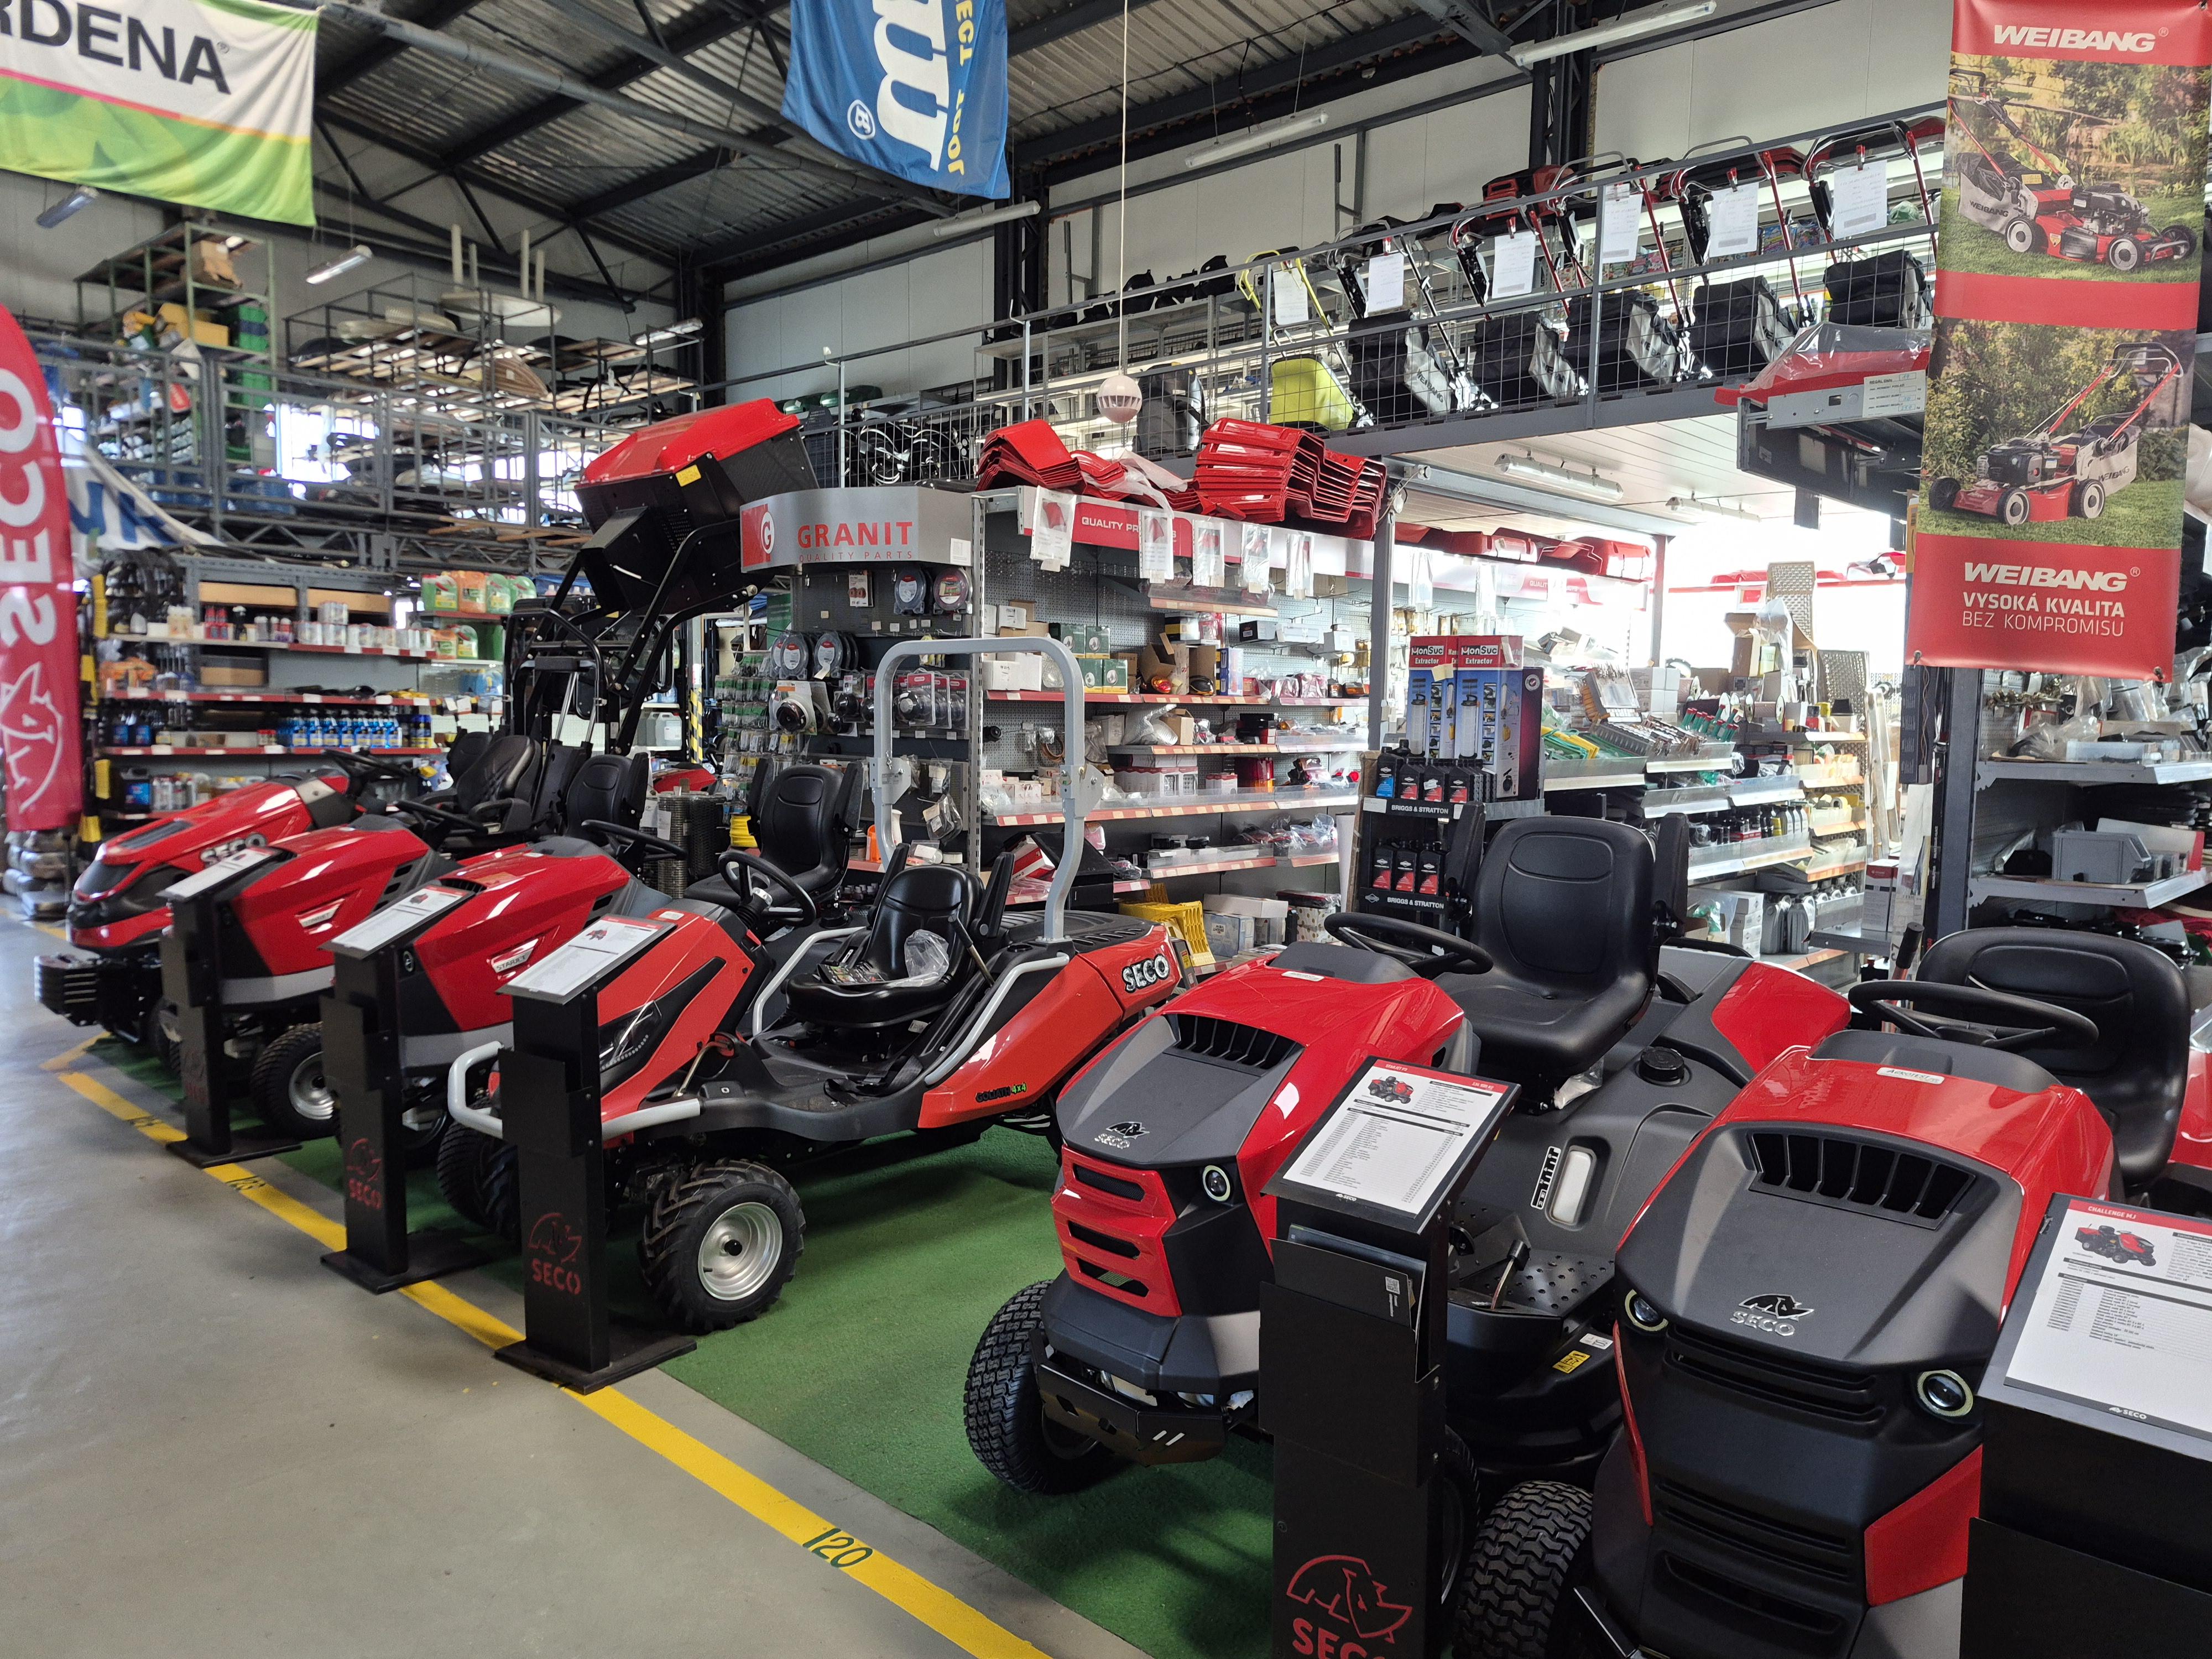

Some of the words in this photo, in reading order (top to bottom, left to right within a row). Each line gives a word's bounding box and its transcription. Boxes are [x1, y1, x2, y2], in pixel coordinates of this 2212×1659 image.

[0, 0, 231, 95] DENA
[1994, 25, 2156, 53] WEIBANG
[1969, 200, 2009, 218] WEIBANG
[2098, 466, 2130, 481] WEIBANG
[797, 521, 913, 548] GRANIT
[1082, 516, 1124, 531] QUALITY
[799, 552, 855, 563] QUALITY
[865, 551, 913, 560] PARTS
[1965, 562, 2127, 591] WEIBANG
[1963, 592, 2038, 612] VYSOKÁ
[2046, 597, 2125, 618] KVALITA
[1963, 611, 1995, 628] BEZ
[2004, 614, 2125, 637] KOMPROMISU
[1411, 646, 1444, 655] MonSuc
[1461, 645, 1499, 655] MonSuc
[1414, 900, 1444, 909] STRATTON
[1122, 954, 1170, 993] SECO
[975, 1086, 1011, 1102] GOLIATH
[1011, 1082, 1027, 1094] 4x4
[2088, 1206, 2125, 1218] CHALLENGE
[531, 1259, 581, 1296] SECO
[1730, 1311, 1795, 1337] SECO
[2122, 1409, 2147, 1420] SECO
[803, 1528, 873, 1568] 120
[1292, 1618, 1386, 1659] SEC
